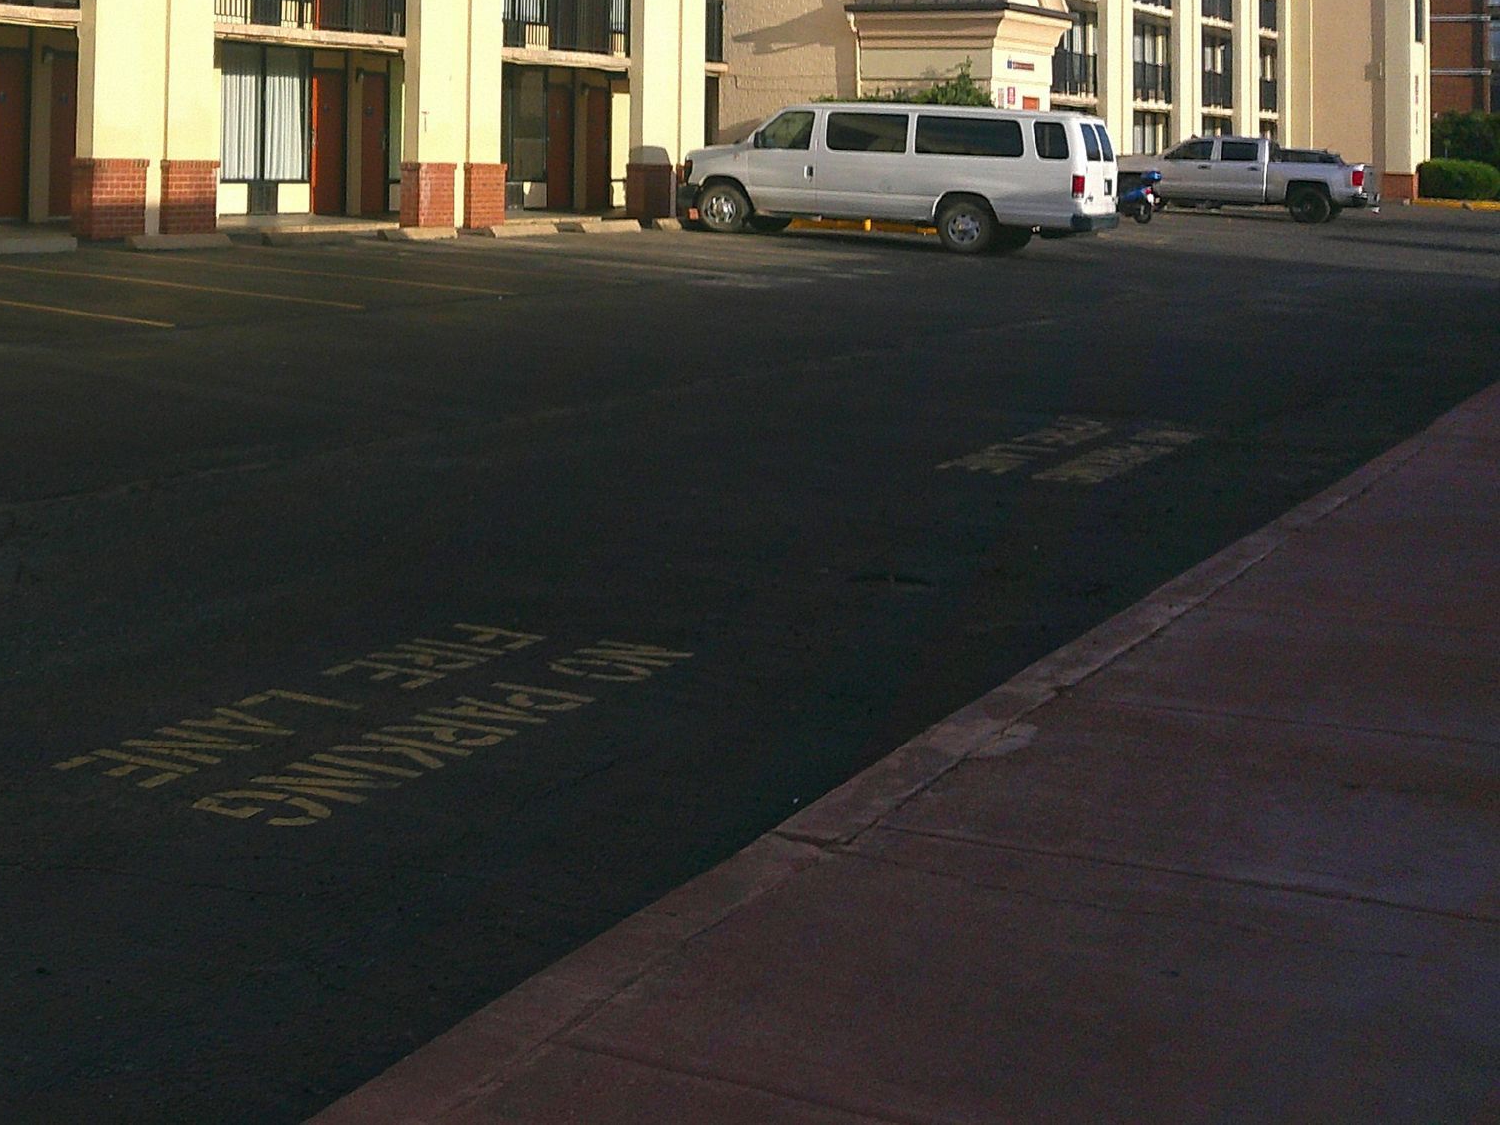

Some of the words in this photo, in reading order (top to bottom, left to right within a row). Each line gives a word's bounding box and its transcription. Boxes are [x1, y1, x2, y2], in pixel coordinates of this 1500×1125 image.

[319, 623, 547, 690] FIRE
[548, 639, 695, 683] NO
[51, 687, 363, 789] LANE
[191, 681, 595, 827] PARKING
